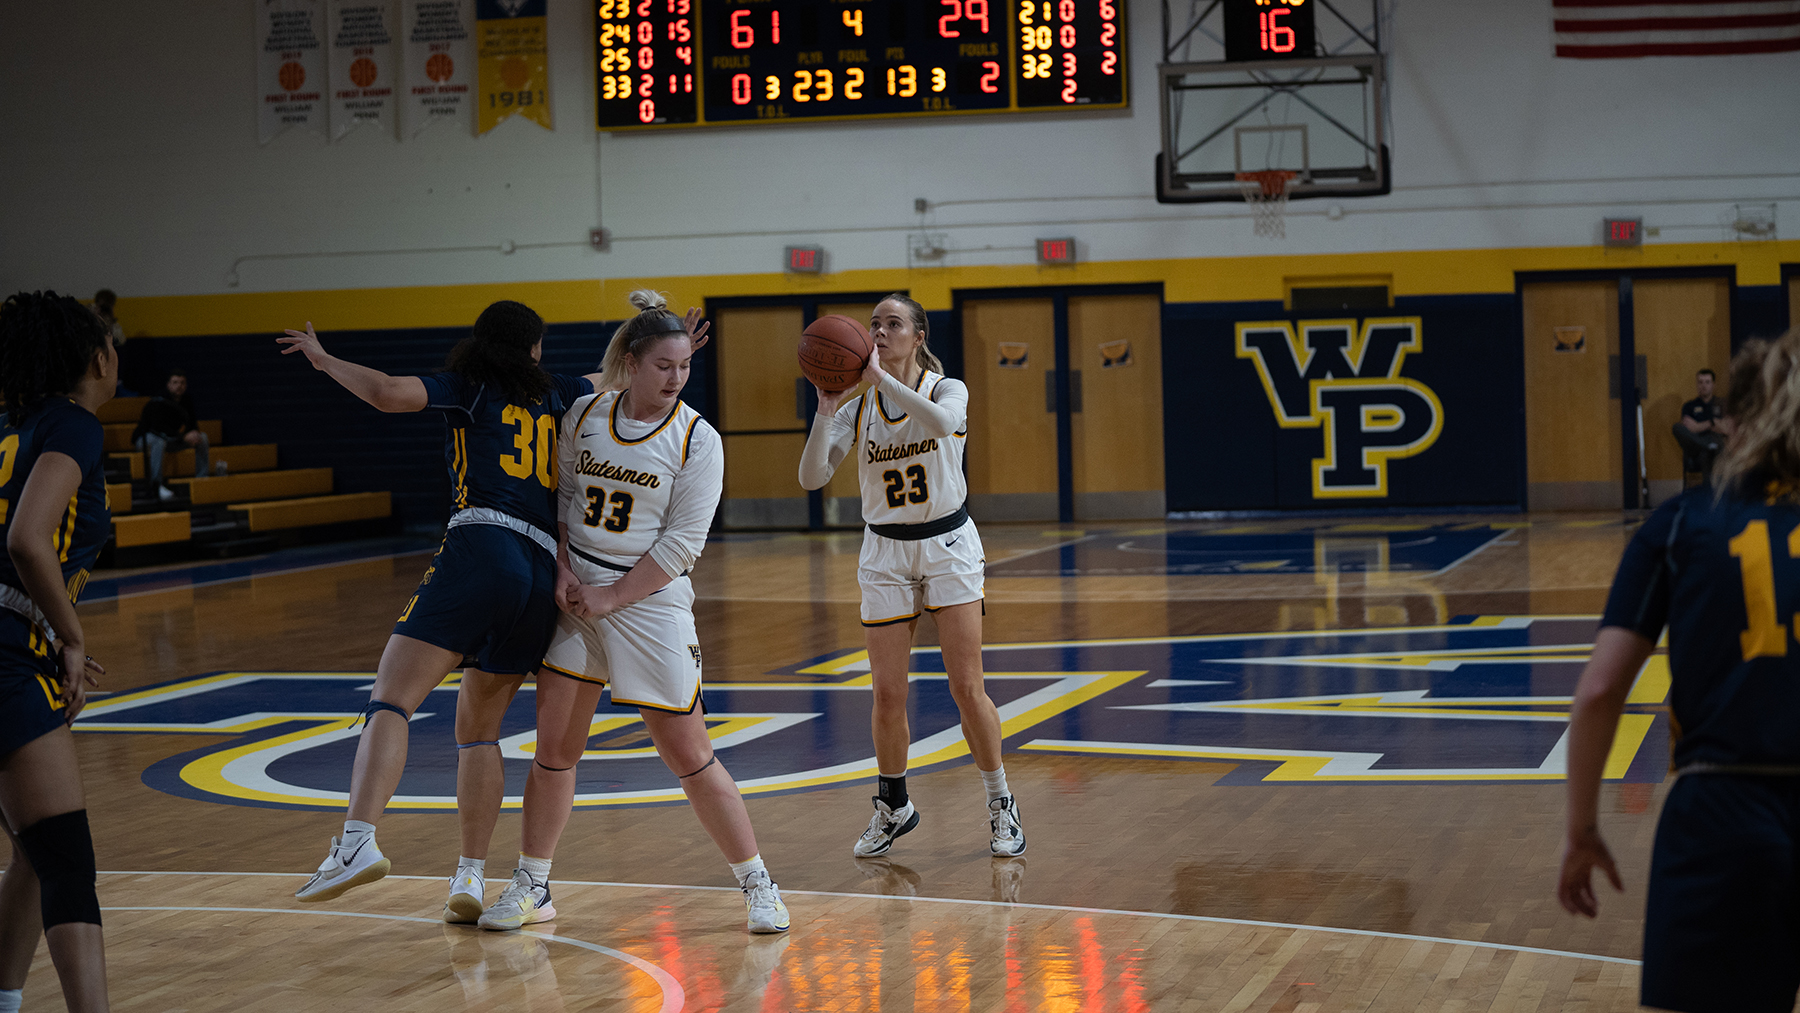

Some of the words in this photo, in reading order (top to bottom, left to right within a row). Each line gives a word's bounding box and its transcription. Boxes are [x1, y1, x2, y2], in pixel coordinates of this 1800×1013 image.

[340, 7, 379, 15] DIVISION
[416, 2, 455, 10] DIVISION
[599, 0, 630, 20] 23
[637, 0, 653, 17] 2
[667, 0, 691, 15] 13
[1018, 0, 1052, 25] 21
[1059, 0, 1076, 22] 0
[1098, 0, 1116, 21] 6
[270, 10, 308, 20] DIVISION
[417, 17, 460, 26] NATIONAL
[842, 9, 864, 37] 4
[938, 0, 990, 38] 29
[271, 27, 312, 36] NATIONAL
[337, 30, 388, 39] BASKETBALL
[341, 22, 384, 31] NATIONAL
[413, 25, 464, 34] BASKETBALL
[599, 22, 631, 47] 24
[637, 20, 654, 45] 0
[667, 18, 692, 43] 15
[730, 9, 781, 49] 61
[1259, 7, 1296, 53] 16
[266, 35, 316, 44] BASKETBALL
[335, 38, 392, 48] TOURNAMENT
[410, 33, 468, 43] TOURNAMENT
[1021, 25, 1053, 51] 30
[1059, 23, 1077, 49] 0
[1100, 22, 1116, 47] 2
[264, 42, 319, 52] TOURNAMENT
[884, 46, 905, 60] PTS
[958, 42, 999, 57] FOULS
[600, 47, 632, 73] 25
[637, 46, 654, 71] 0
[675, 45, 692, 66] 4
[712, 54, 751, 69] FOULS
[797, 50, 824, 65] PLYR
[837, 49, 869, 63] FOUL
[1022, 53, 1053, 80] 32
[1063, 52, 1077, 77] 3
[1101, 50, 1117, 75] 2
[411, 86, 435, 95] FIRST
[438, 84, 469, 94] ROUND
[602, 73, 632, 100] 33
[638, 73, 655, 98] 2
[668, 73, 693, 94] 11
[731, 73, 752, 105] 0
[765, 75, 781, 101] 3
[792, 68, 834, 103] 23
[843, 66, 865, 101] 2
[886, 64, 918, 98] 13
[930, 66, 947, 93] 3
[980, 60, 1001, 94] 2
[1060, 78, 1078, 104] 2
[265, 94, 287, 103] FIRST
[290, 92, 320, 102] ROUND
[336, 90, 359, 99] FIRST
[362, 88, 392, 97] ROUND
[421, 96, 461, 105] WILLIAM
[489, 90, 545, 108] 1981
[274, 104, 313, 113] WILLIAM
[344, 100, 384, 110] WILLIAM
[428, 107, 456, 116] PENN
[638, 98, 656, 123] 0
[281, 115, 308, 123] PENN
[353, 111, 379, 119] PENN
[1610, 220, 1637, 241] EXIT
[1042, 240, 1067, 260] EXIT
[791, 249, 816, 269] EXIT
[1235, 316, 1444, 500] WP
[499, 403, 558, 493] 30
[867, 437, 940, 465] Statesmen
[574, 449, 661, 490] Statesmen
[882, 463, 930, 511] 23
[584, 485, 636, 535] 33
[1727, 517, 1800, 663] 1
